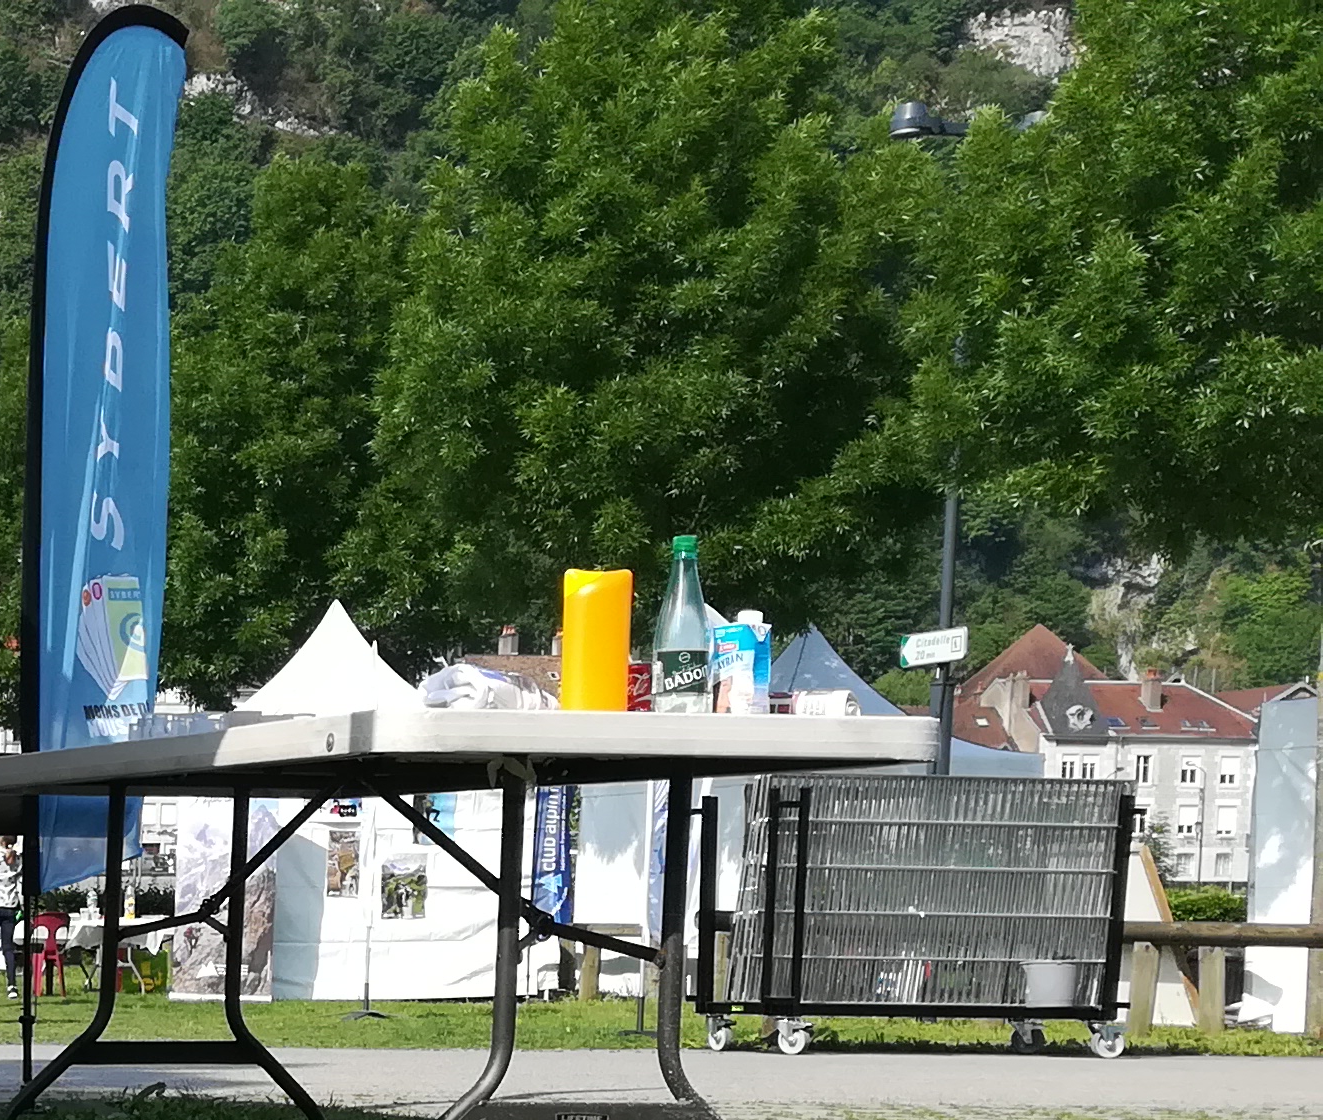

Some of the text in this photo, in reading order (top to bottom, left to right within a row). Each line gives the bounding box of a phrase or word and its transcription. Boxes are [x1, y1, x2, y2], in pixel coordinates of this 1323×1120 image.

[90, 75, 138, 550] SYBERT
[916, 636, 951, 648] Citadelle
[915, 651, 925, 661] 20
[84, 705, 120, 720] MOINS
[121, 703, 137, 717] DE
[541, 838, 557, 871] club
